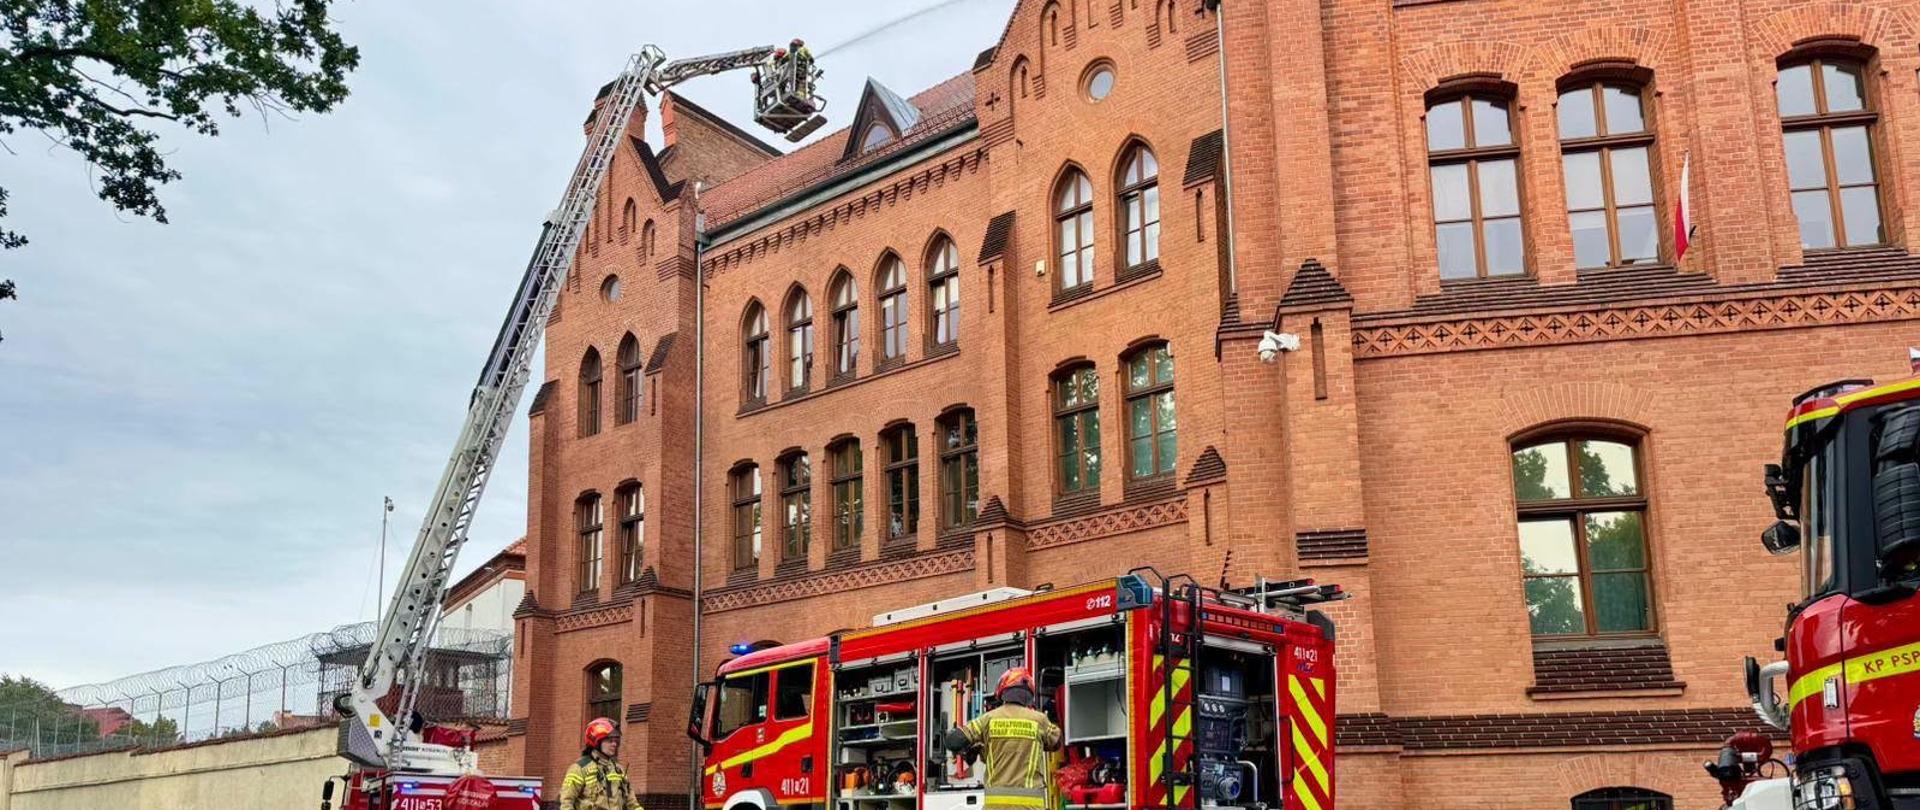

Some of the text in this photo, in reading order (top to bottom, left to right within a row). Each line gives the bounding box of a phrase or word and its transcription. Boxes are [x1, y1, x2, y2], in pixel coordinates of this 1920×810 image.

[1095, 594, 1111, 608] 112
[1864, 651, 1920, 673] KP PSP
